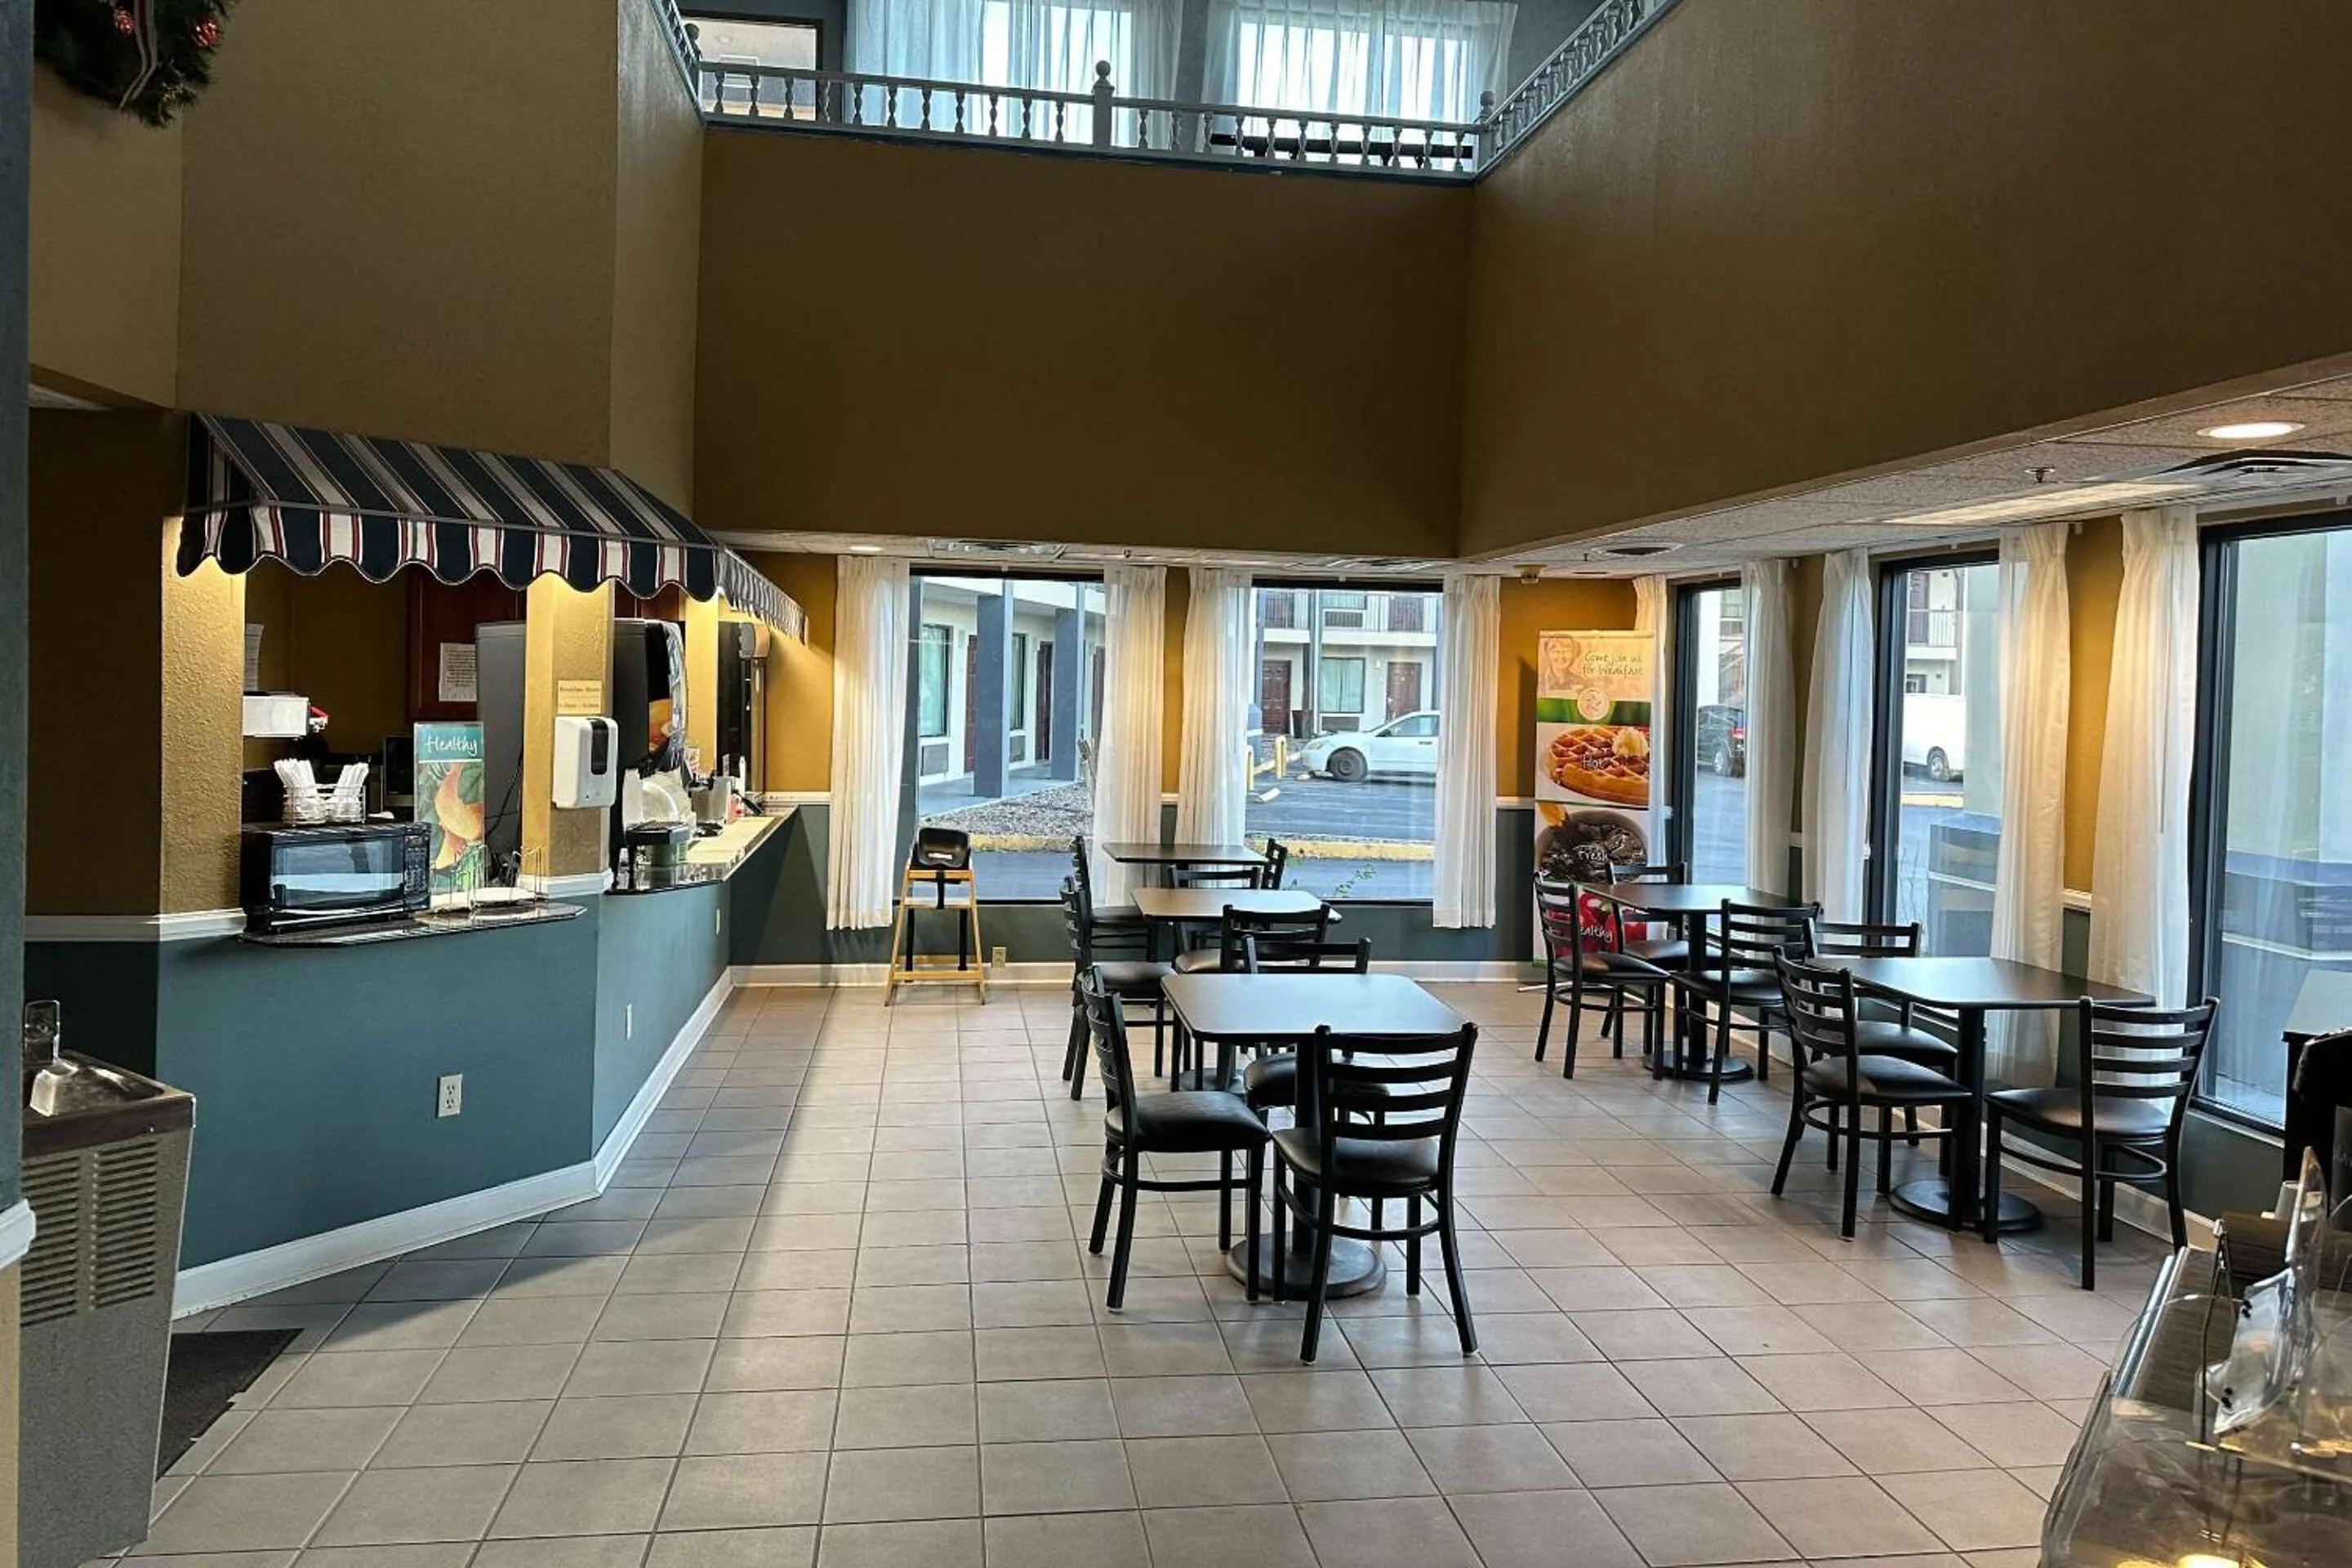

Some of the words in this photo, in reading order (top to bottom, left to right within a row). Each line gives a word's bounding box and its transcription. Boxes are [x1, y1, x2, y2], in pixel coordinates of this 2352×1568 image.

[425, 734, 478, 756] Healthy
[1581, 754, 1605, 769] Hot
[1576, 848, 1608, 862] Fresh
[1579, 924, 1613, 942] ealthy
